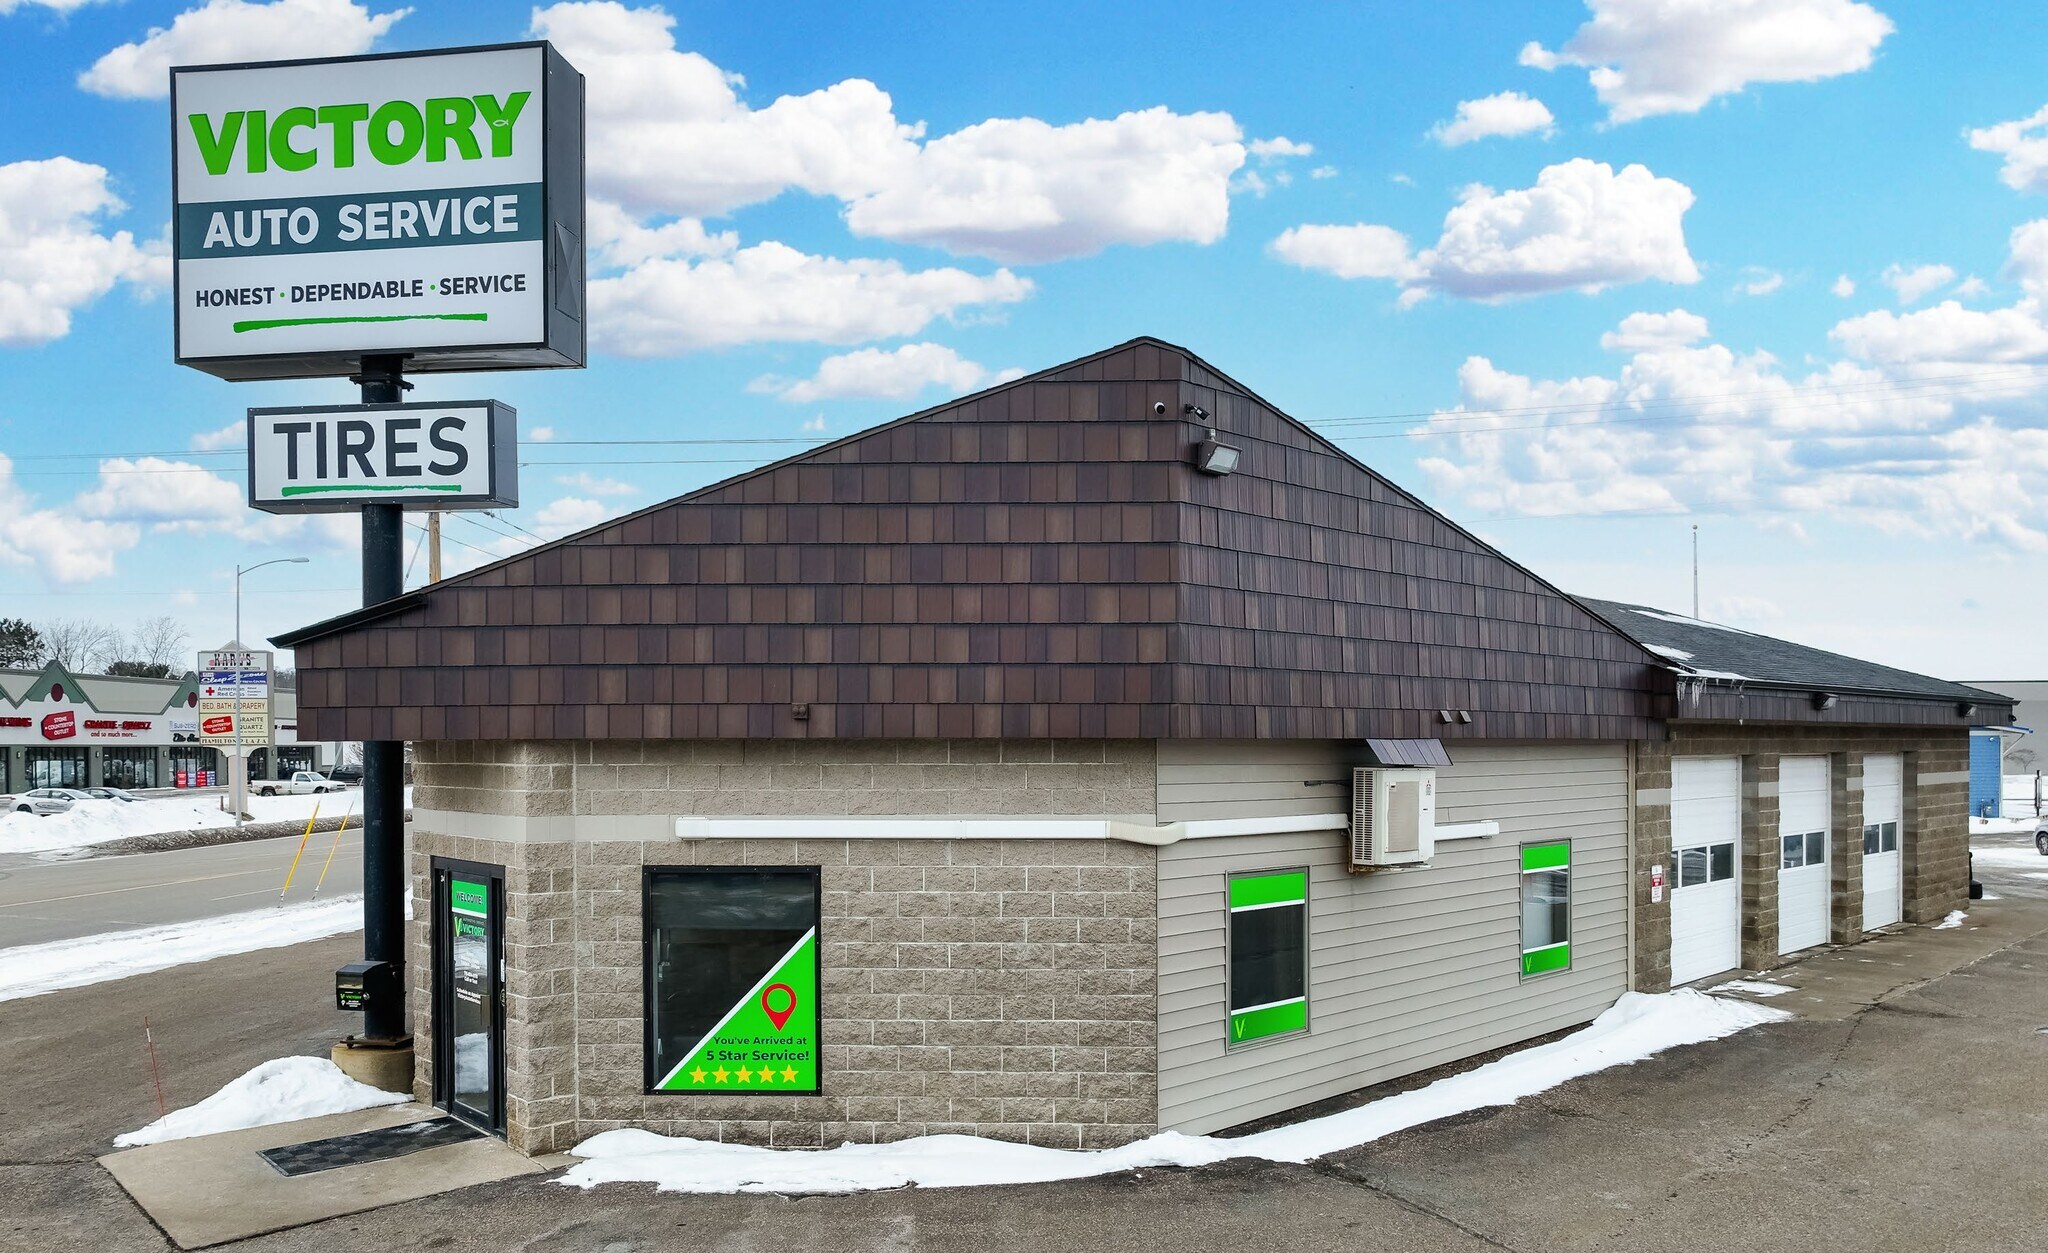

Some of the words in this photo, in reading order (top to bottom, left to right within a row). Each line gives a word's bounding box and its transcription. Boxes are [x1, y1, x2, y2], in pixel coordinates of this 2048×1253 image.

[188, 91, 532, 175] VICTORY
[203, 206, 320, 249] AUTO
[337, 194, 519, 241] SERVICE
[196, 286, 275, 308] HONEST
[290, 279, 424, 303] DEPENDABLE
[439, 273, 527, 296] SERVICE
[273, 416, 469, 480] TIRES
[214, 653, 252, 666] KAR'S
[217, 702, 232, 710] BATH
[713, 1036, 750, 1045] You've
[753, 1036, 793, 1045] Arrived
[796, 1037, 807, 1045] at
[706, 1050, 715, 1061] 5
[718, 1050, 748, 1061] Star
[752, 1049, 809, 1061] Service!
